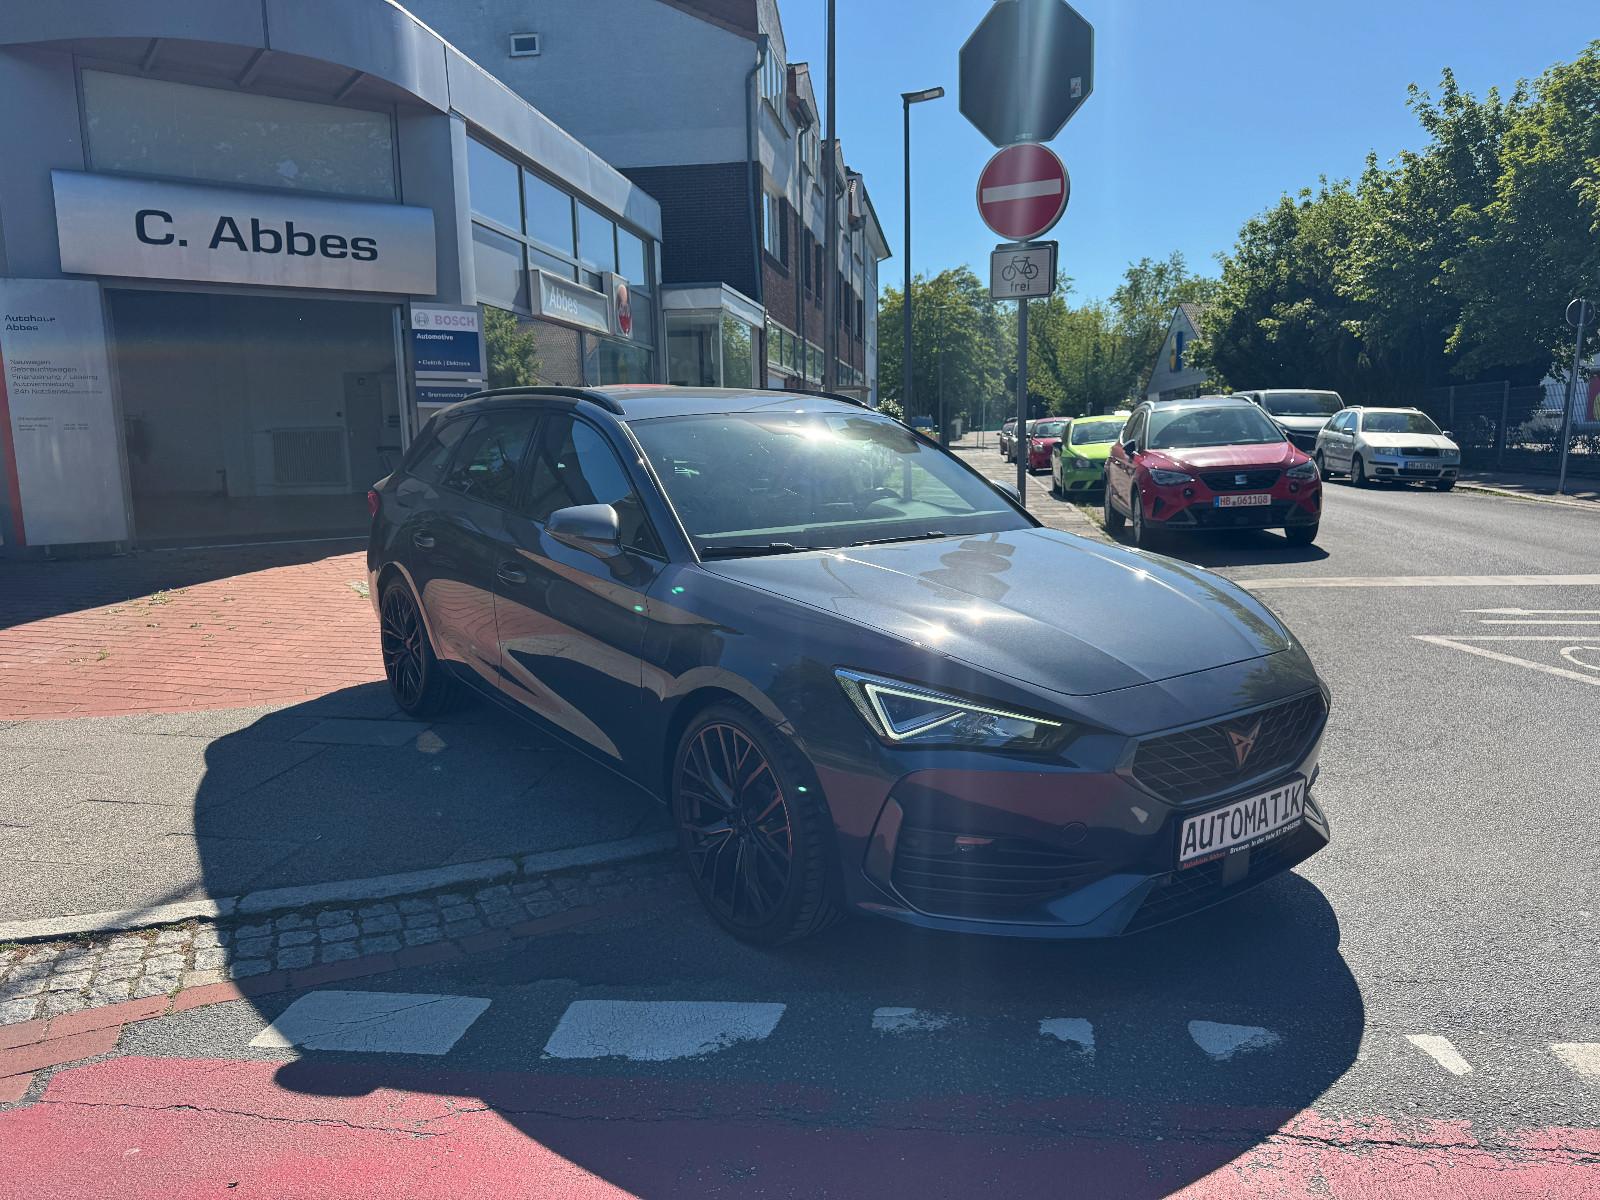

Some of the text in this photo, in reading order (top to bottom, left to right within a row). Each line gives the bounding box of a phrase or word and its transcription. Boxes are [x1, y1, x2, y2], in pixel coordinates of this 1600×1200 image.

[134, 209, 378, 262] C. Abbes
[1010, 280, 1031, 293] frei
[549, 286, 578, 315] Abbes
[5, 323, 39, 331] Abbes
[434, 315, 475, 327] BOSCH
[416, 333, 454, 341] Automotive
[1182, 783, 1303, 856] AUTOMATIK
